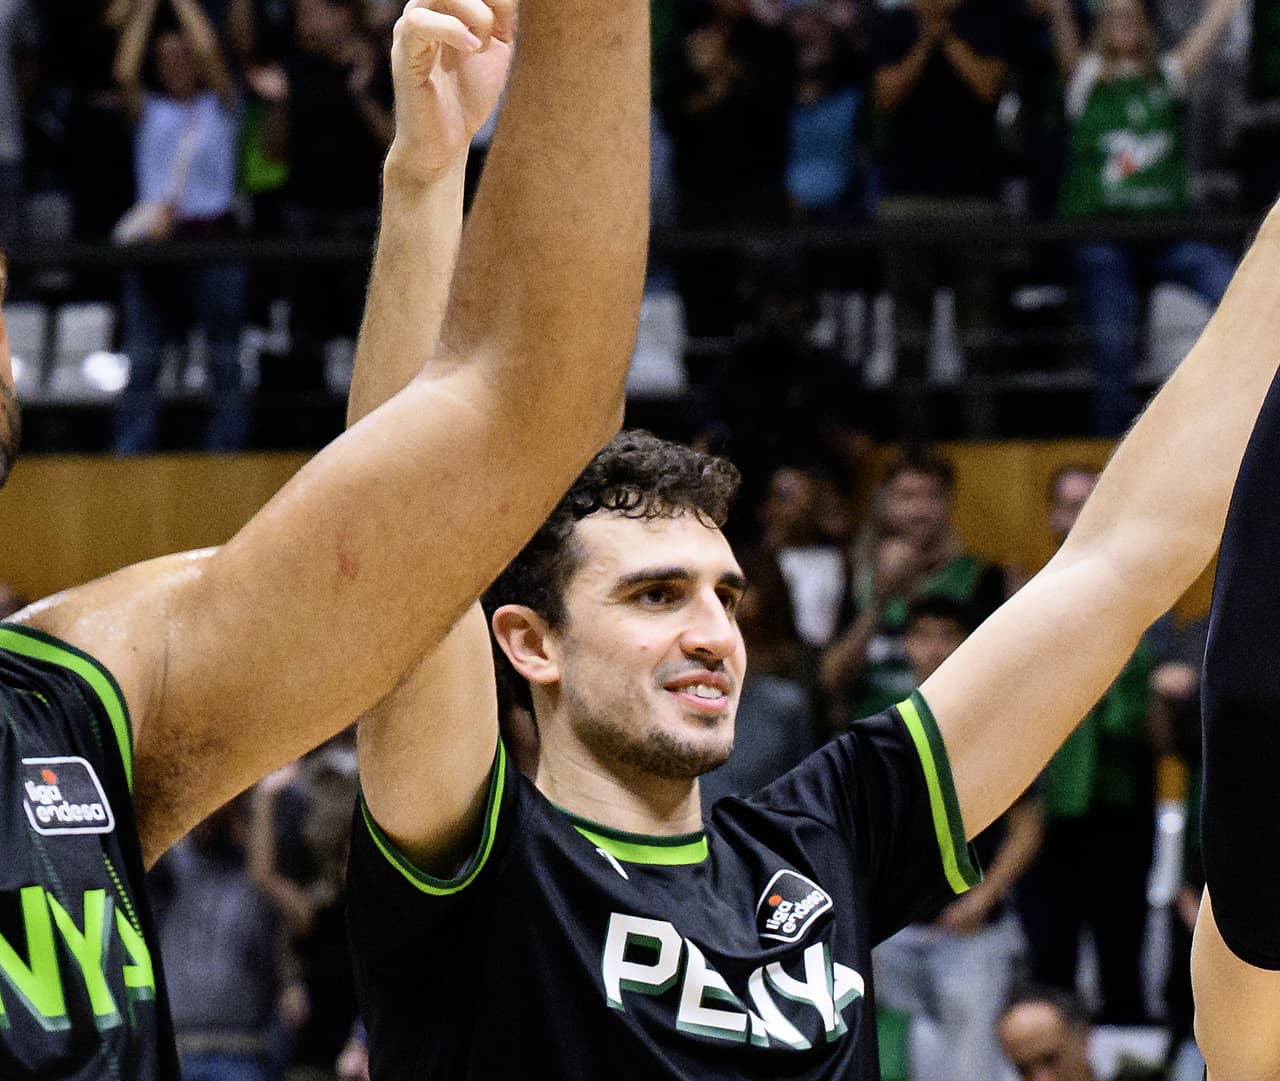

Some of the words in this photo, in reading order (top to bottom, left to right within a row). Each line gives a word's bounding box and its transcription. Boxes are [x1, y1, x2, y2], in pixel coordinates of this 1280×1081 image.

[36, 800, 106, 823] endesa
[765, 899, 793, 930] liga
[782, 889, 825, 934] endesa
